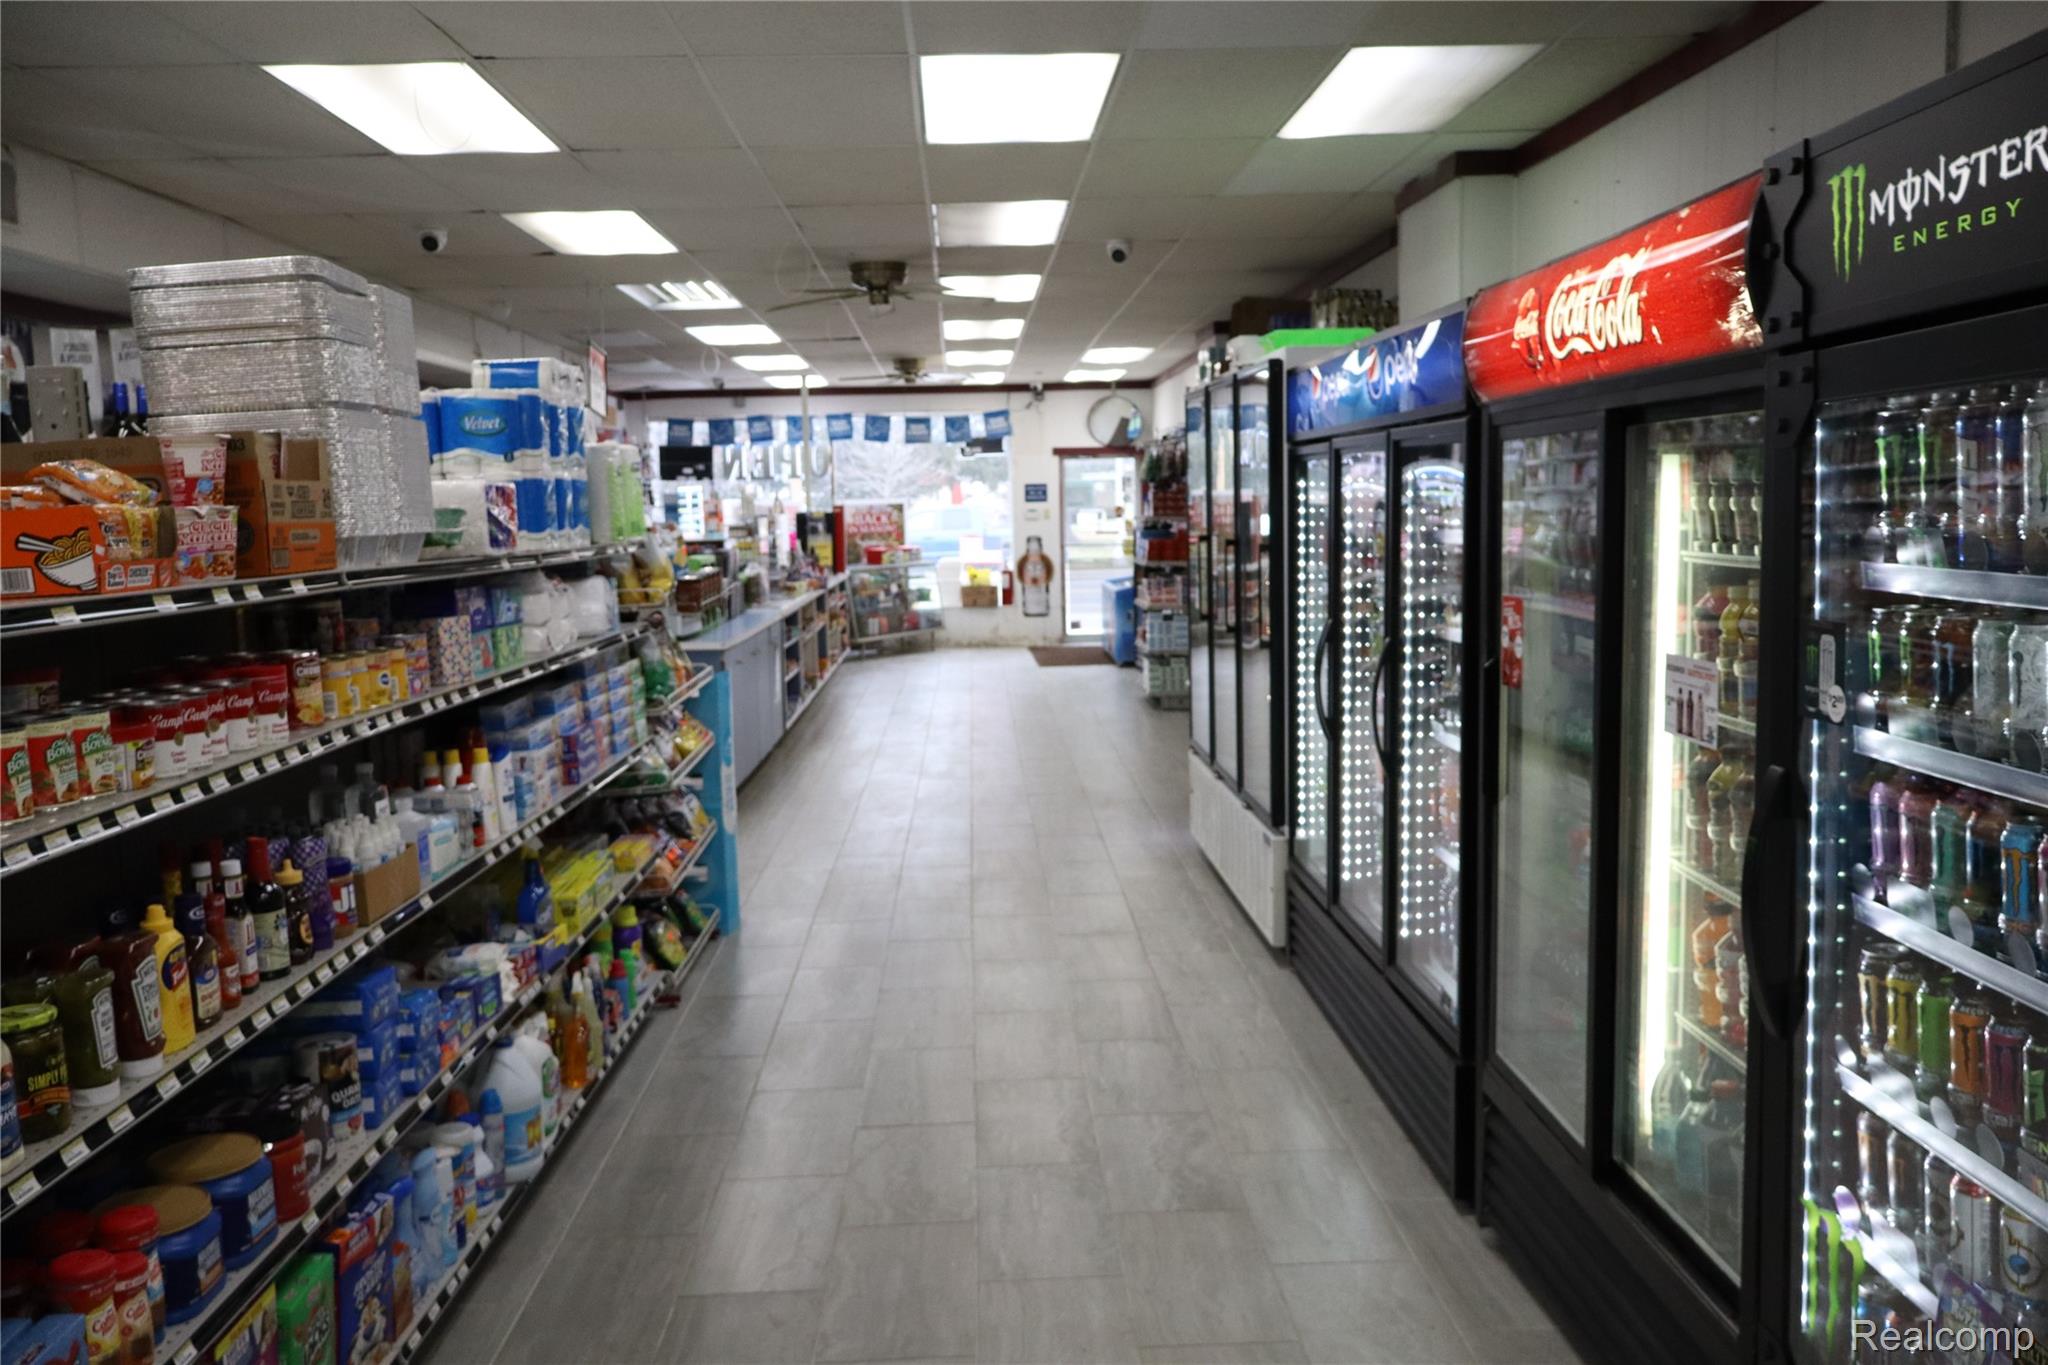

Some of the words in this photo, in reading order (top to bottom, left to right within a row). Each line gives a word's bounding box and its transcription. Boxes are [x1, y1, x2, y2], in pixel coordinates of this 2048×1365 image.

[1868, 124, 2048, 228] MONSTER
[1892, 198, 2022, 253] ENERGY
[461, 415, 502, 431] Velvet
